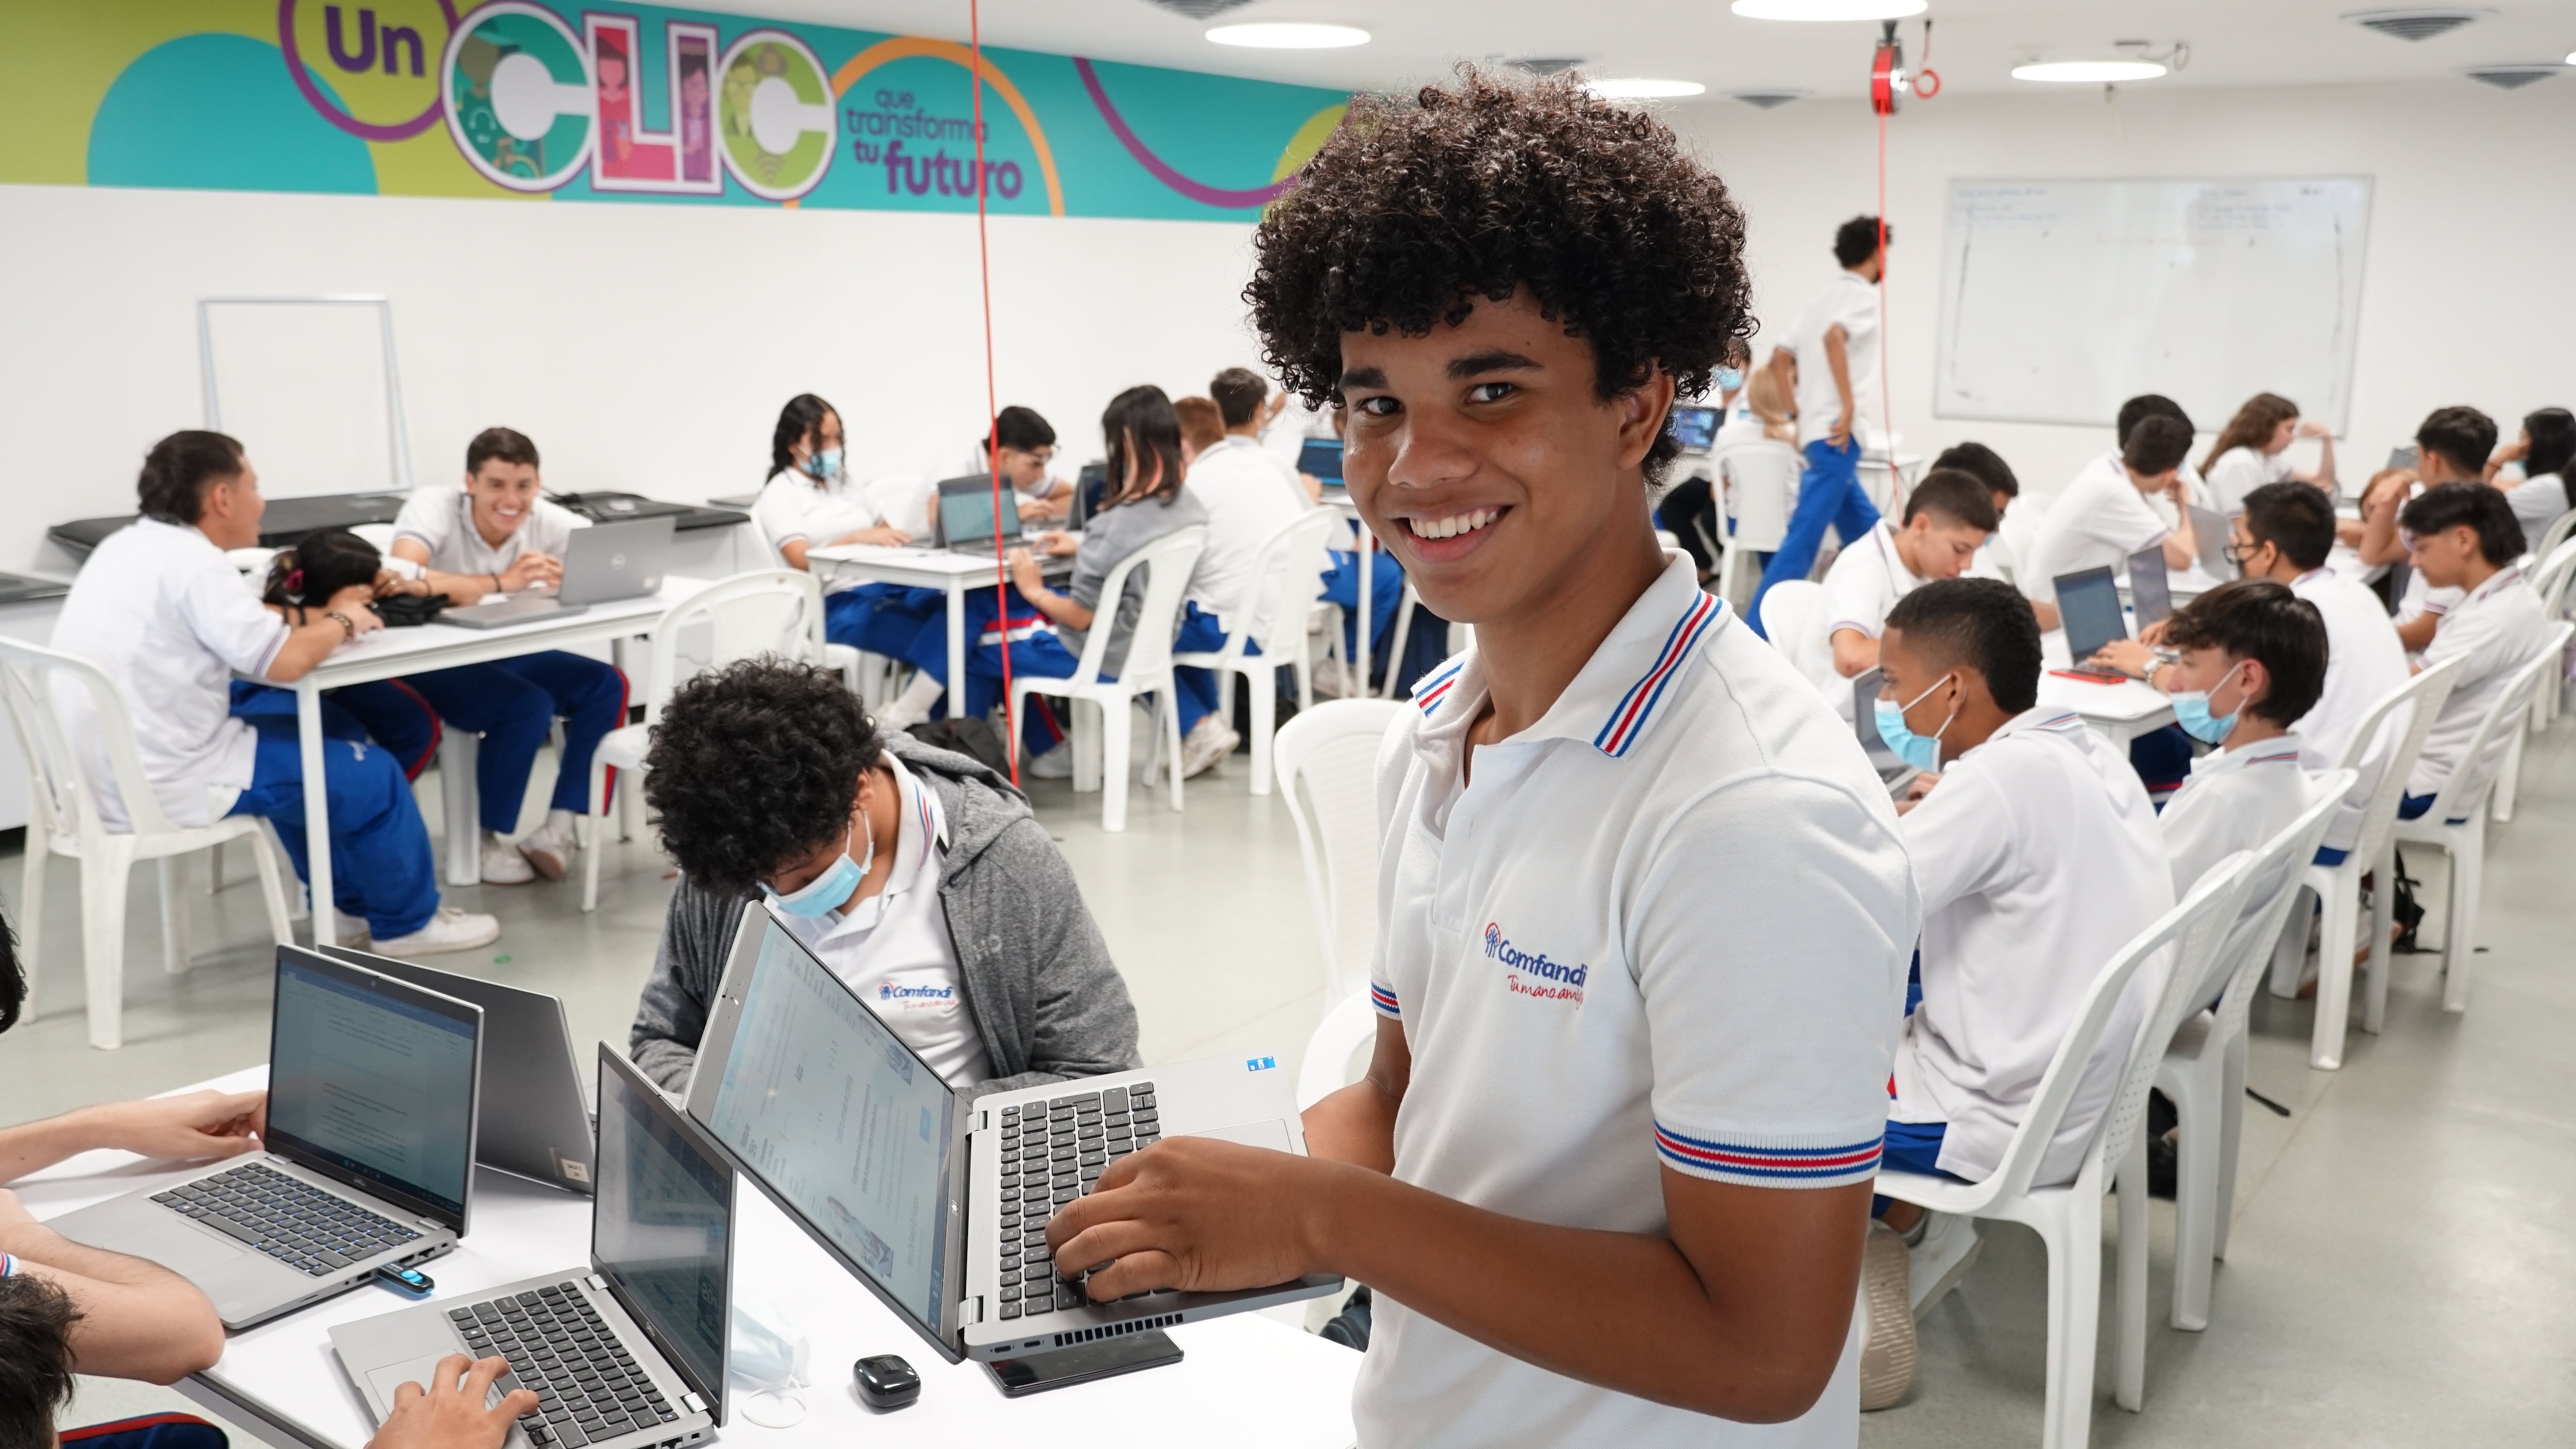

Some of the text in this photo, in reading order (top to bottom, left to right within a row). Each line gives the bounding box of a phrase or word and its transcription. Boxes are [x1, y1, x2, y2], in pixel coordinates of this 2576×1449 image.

[324, 5, 426, 78] Un
[440, 0, 837, 201] CLIC
[875, 87, 915, 110] que
[846, 107, 989, 143] transforma
[854, 139, 879, 164] tu
[883, 139, 1024, 200] futuro
[1498, 939, 1588, 988] Comfandi
[892, 985, 953, 999] Comfandi
[794, 1063, 804, 1082] Autor
